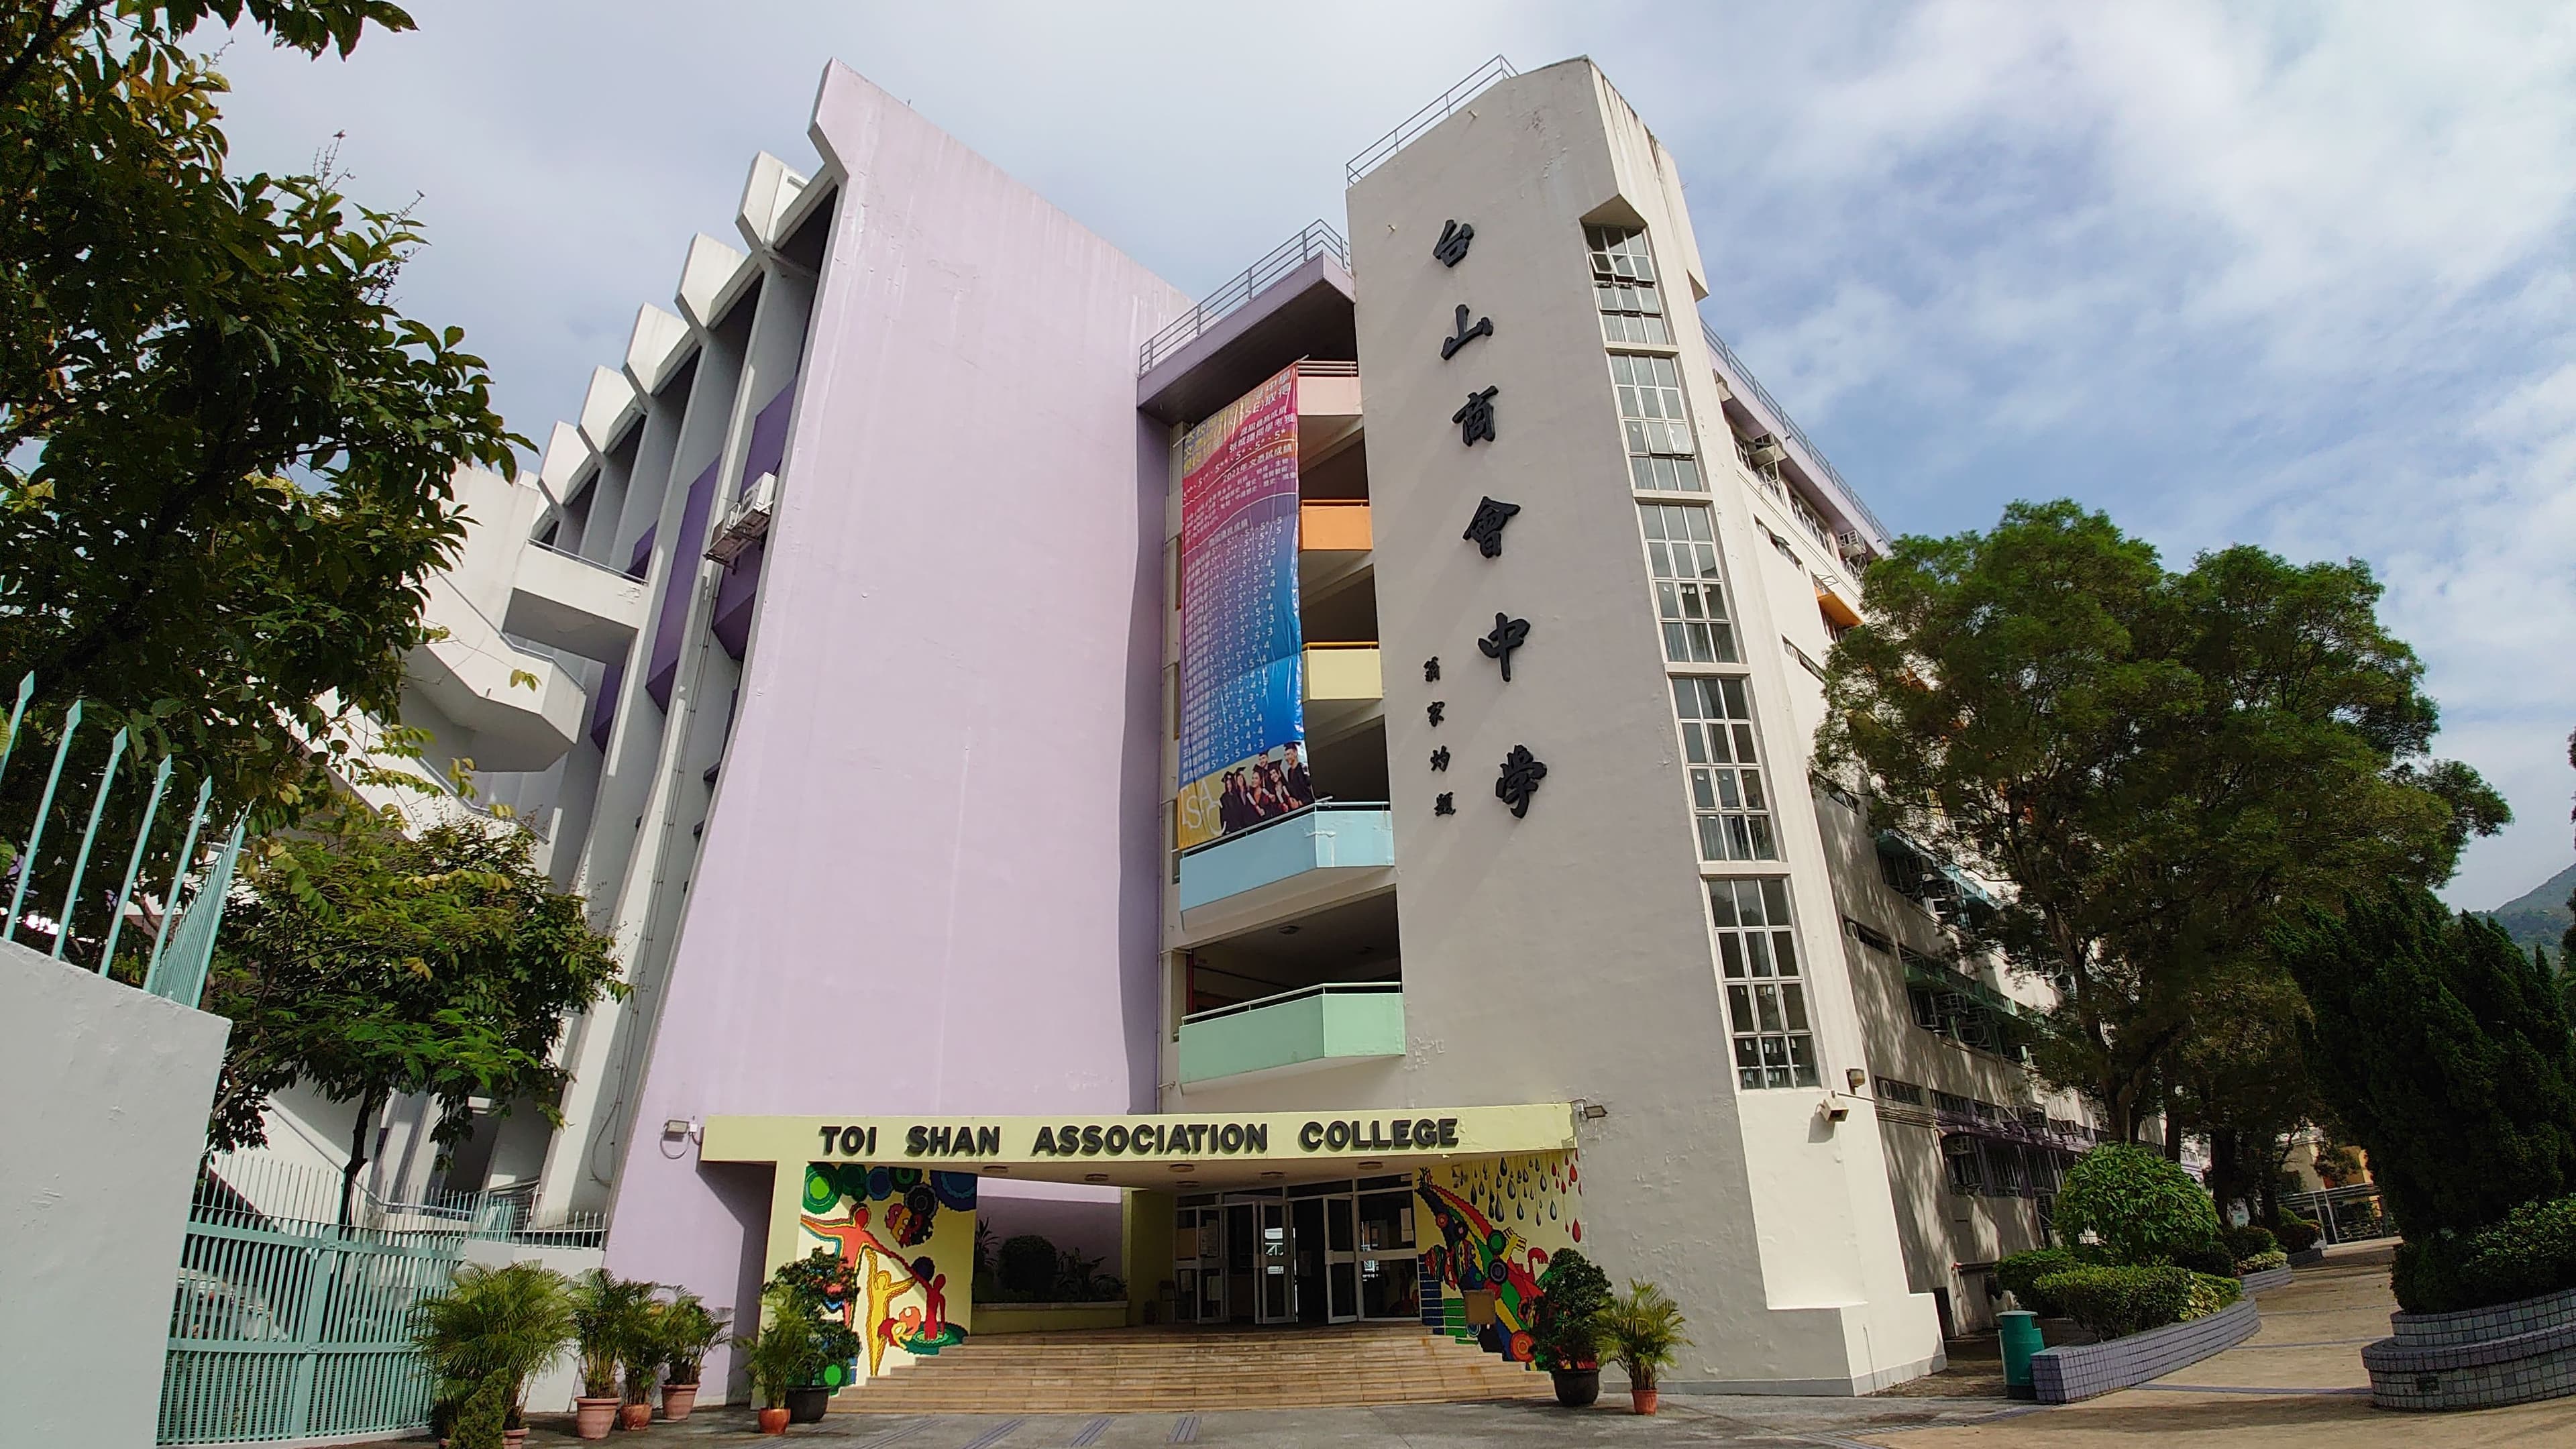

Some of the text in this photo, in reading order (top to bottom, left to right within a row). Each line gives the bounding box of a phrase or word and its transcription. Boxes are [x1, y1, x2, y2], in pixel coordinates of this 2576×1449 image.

[820, 1118, 1460, 1155] TOI SHAN ASSOCIATION COLLEGE
